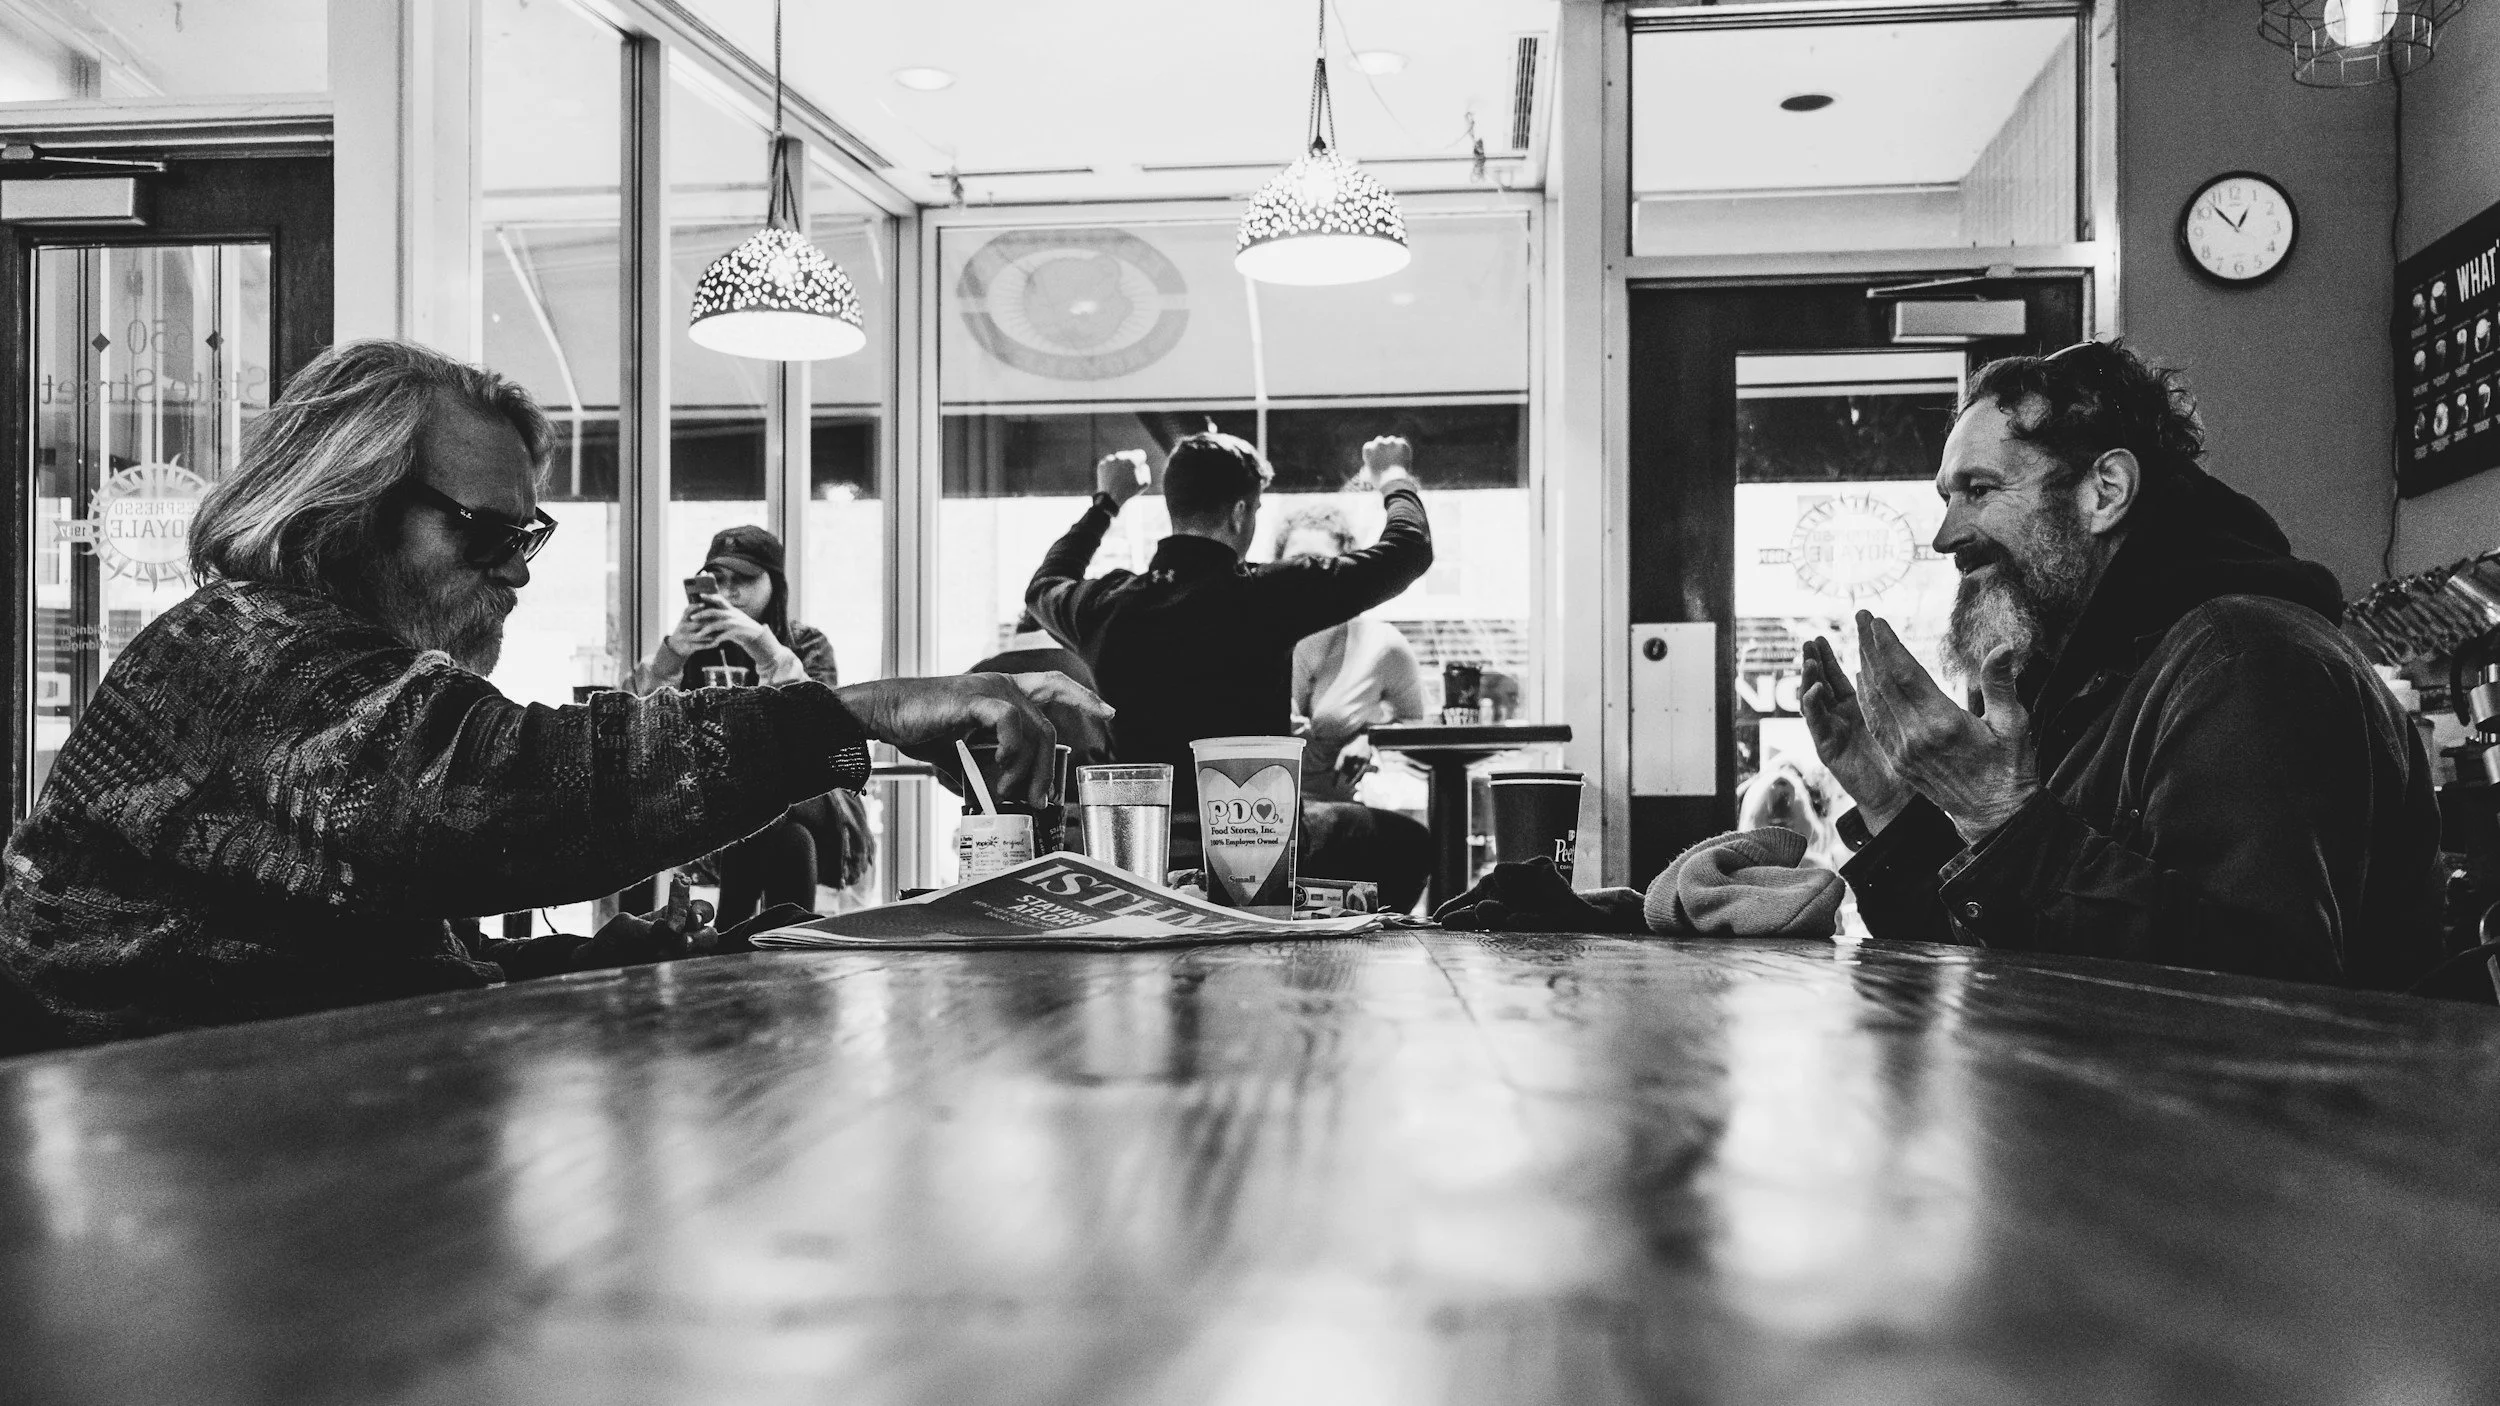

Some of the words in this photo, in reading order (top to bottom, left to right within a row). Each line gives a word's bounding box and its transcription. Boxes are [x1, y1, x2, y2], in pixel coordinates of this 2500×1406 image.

[1207, 798, 1279, 825] PDQ
[1211, 826, 1229, 835] Food
[1230, 825, 1259, 835] Stores,
[1260, 825, 1277, 834] Inc.
[1225, 838, 1256, 847] Employee
[1256, 837, 1279, 846] Owned
[1229, 875, 1256, 883] Small
[1016, 863, 1243, 931] ISTHM
[1016, 894, 1099, 923] STAYING
[1007, 904, 1084, 927] AFLOAT
